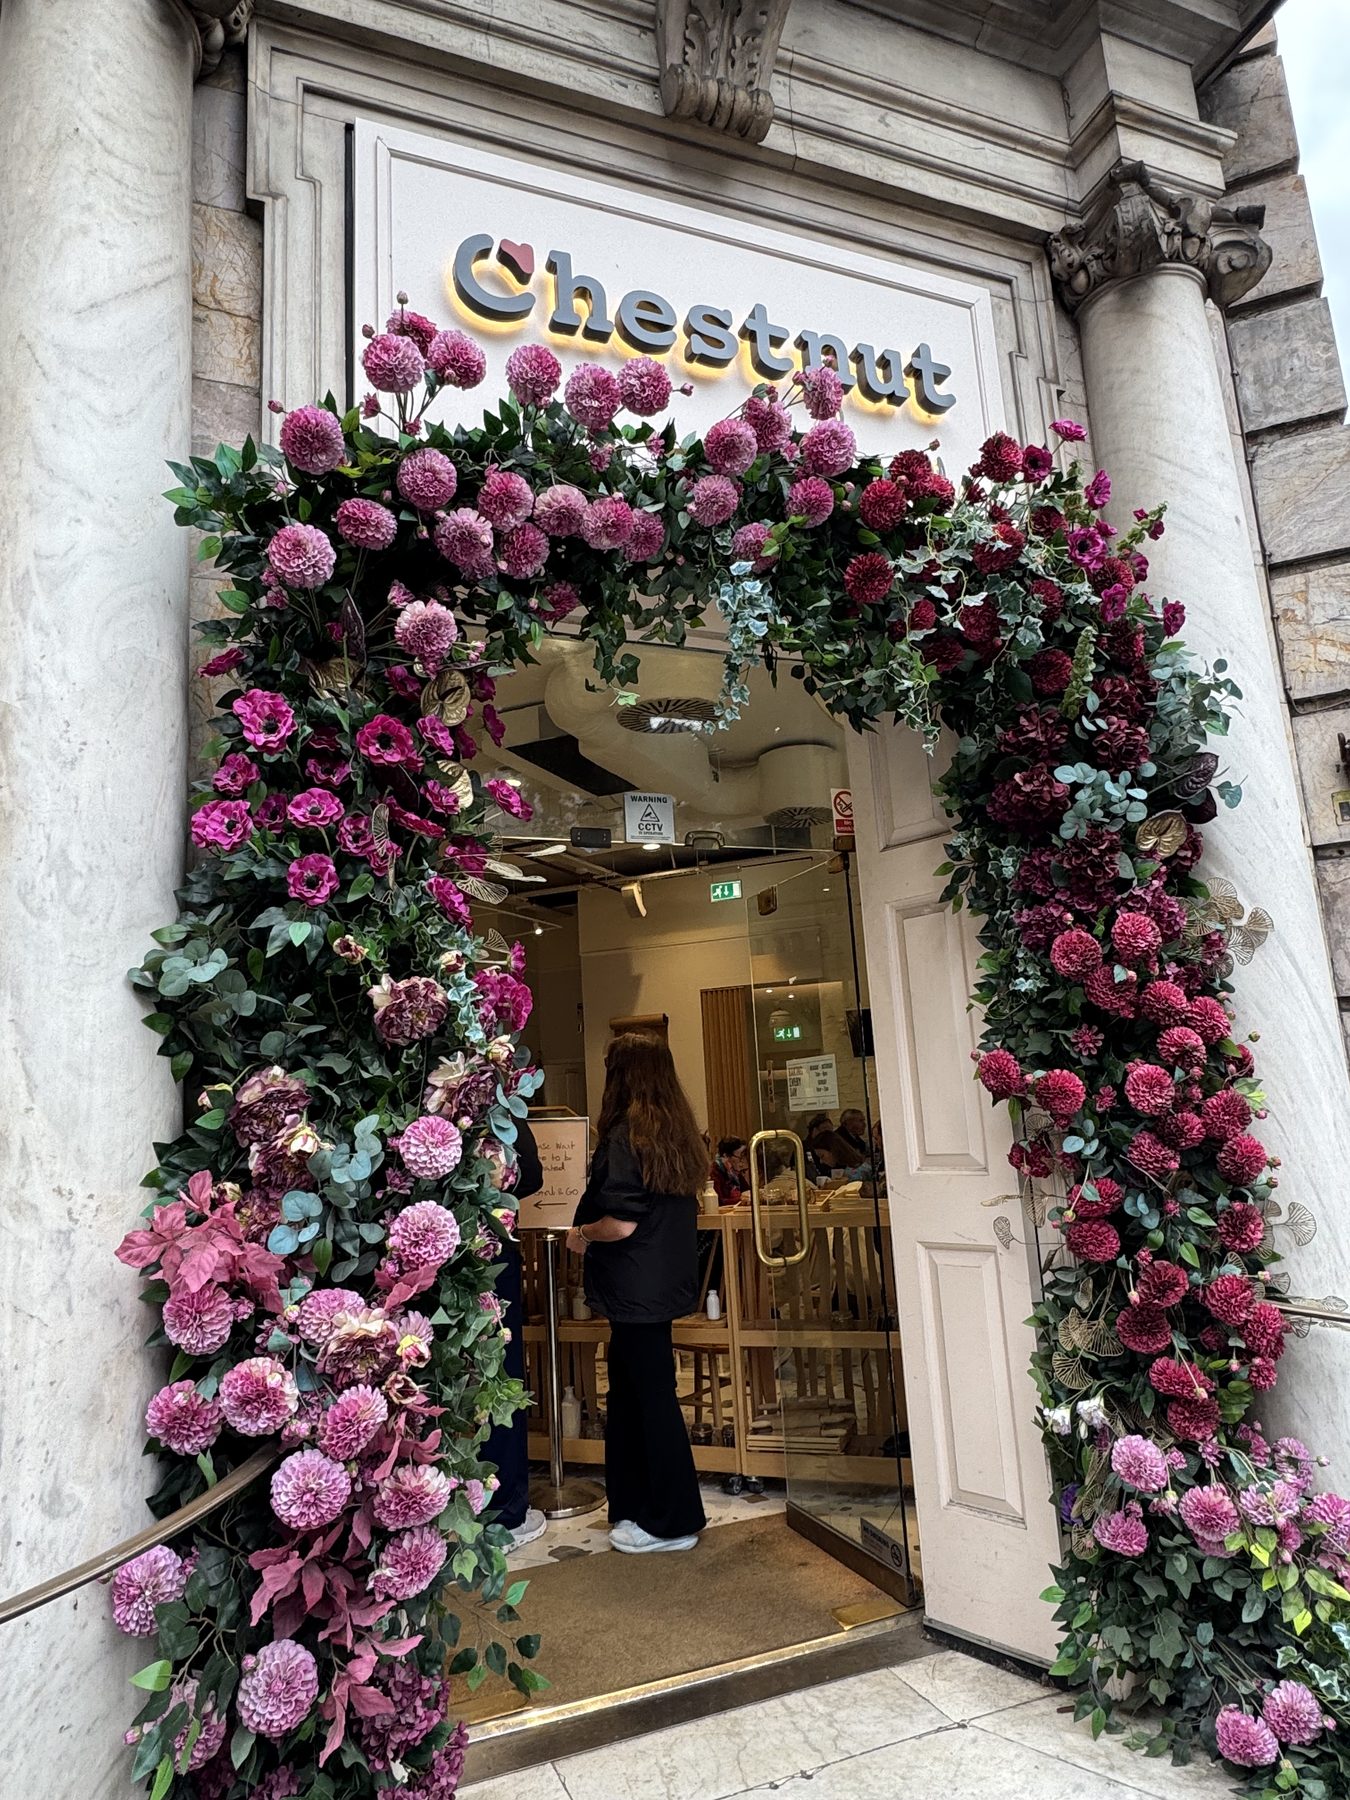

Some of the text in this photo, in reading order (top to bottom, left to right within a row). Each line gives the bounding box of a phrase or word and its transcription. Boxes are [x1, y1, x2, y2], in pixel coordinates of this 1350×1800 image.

[452, 233, 957, 415] Chestnut
[630, 795, 668, 803] WARNING
[638, 822, 663, 831] CCTV
